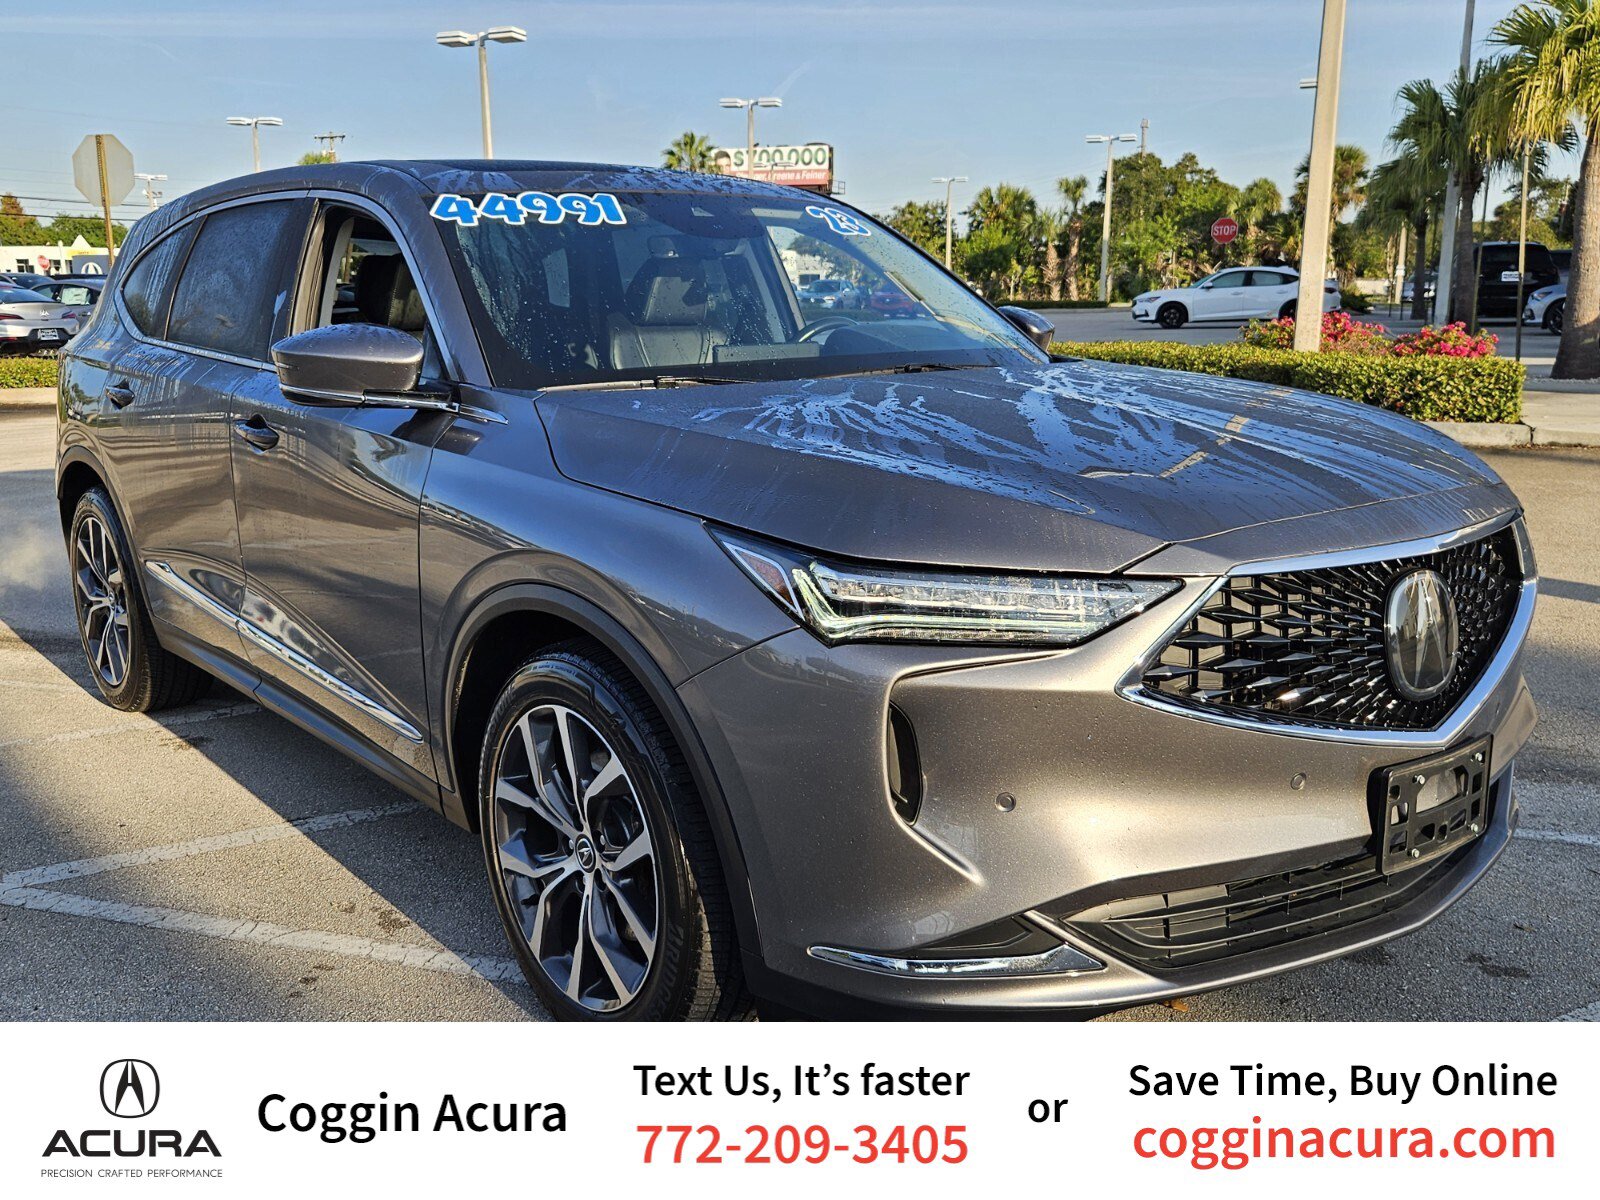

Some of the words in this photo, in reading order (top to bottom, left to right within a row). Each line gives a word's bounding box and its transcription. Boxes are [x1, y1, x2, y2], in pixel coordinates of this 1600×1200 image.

[733, 147, 827, 167] $700000
[801, 170, 827, 180] Feiner
[429, 191, 627, 226] 44991
[1213, 225, 1236, 236] STOP
